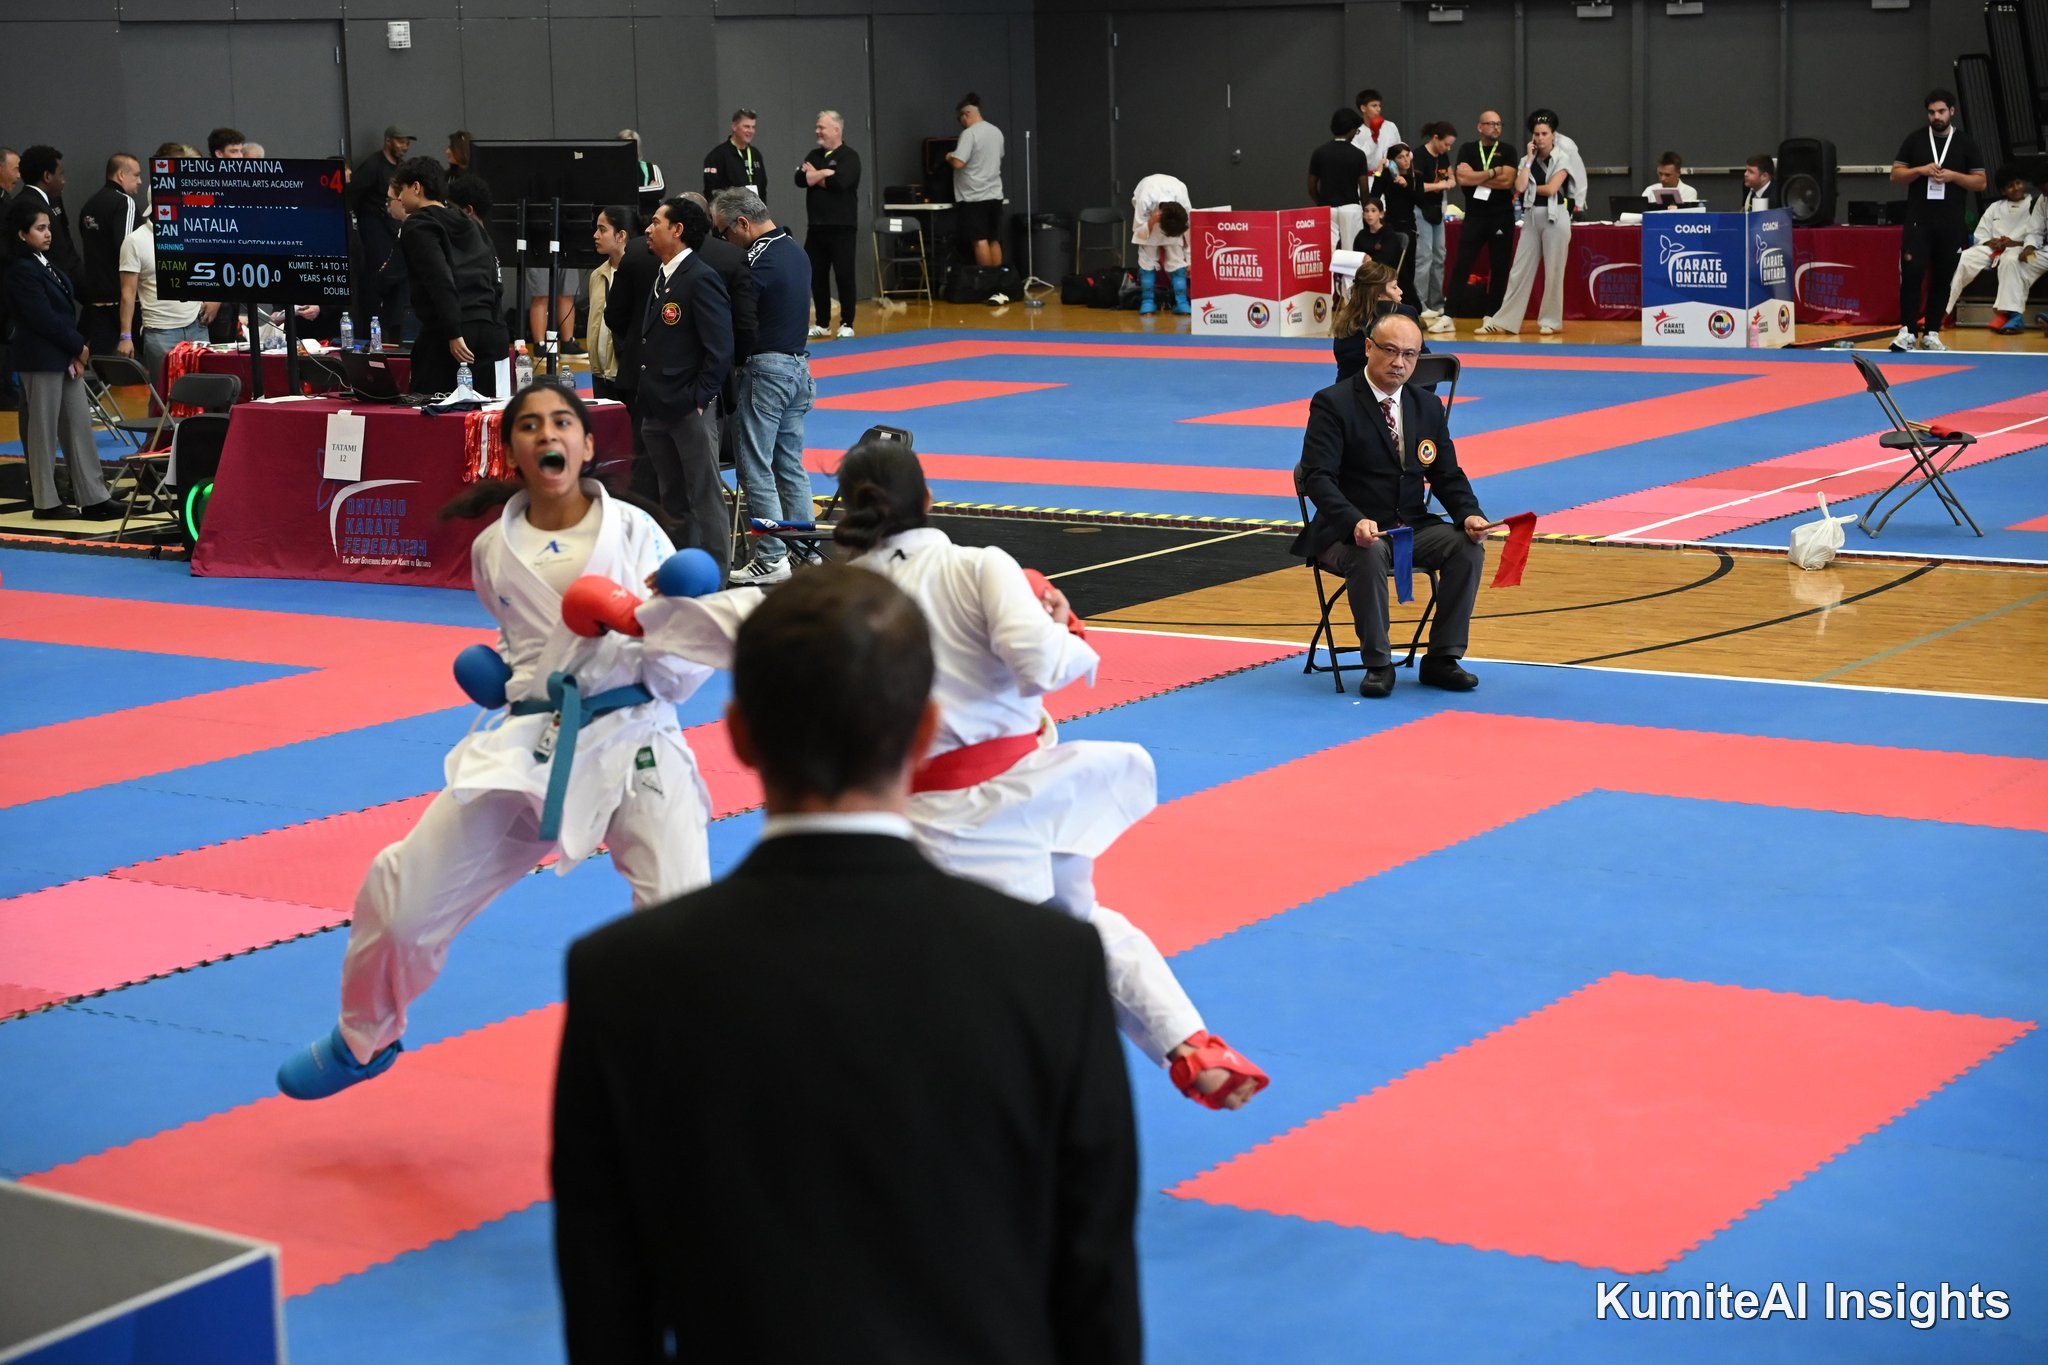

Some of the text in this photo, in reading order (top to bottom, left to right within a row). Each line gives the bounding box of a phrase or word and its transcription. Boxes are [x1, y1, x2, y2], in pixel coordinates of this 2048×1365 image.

[180, 159, 283, 173] PENG ARYANNA
[181, 178, 304, 189] SENSHUKEN MARTIAL ARTS ACADEMY
[183, 218, 239, 233] NATALIA
[1217, 222, 1249, 231] COACH
[1295, 219, 1315, 229] COACH
[1674, 224, 1711, 234] COACH
[1762, 221, 1778, 232] COACH
[1219, 254, 1258, 266] KARATE
[1297, 250, 1320, 263] KARATE
[1763, 254, 1784, 268] KARATE
[288, 261, 314, 270] KUMITE
[320, 262, 329, 270] 14
[330, 262, 340, 270] TO
[1297, 262, 1324, 275] ONTARIO
[1675, 258, 1722, 271] KARATE
[1219, 265, 1263, 277] ONTARIO
[1763, 267, 1786, 281] ONTARIO
[170, 277, 182, 289] 12
[299, 273, 321, 282] YEARS
[336, 274, 347, 283] KG
[1675, 271, 1728, 284] ONTARIO
[332, 443, 357, 453] TATAMI
[339, 454, 347, 462] 12
[346, 498, 406, 516] ONTARIO
[345, 518, 400, 536] KARATE
[343, 537, 427, 557] FEDERATION
